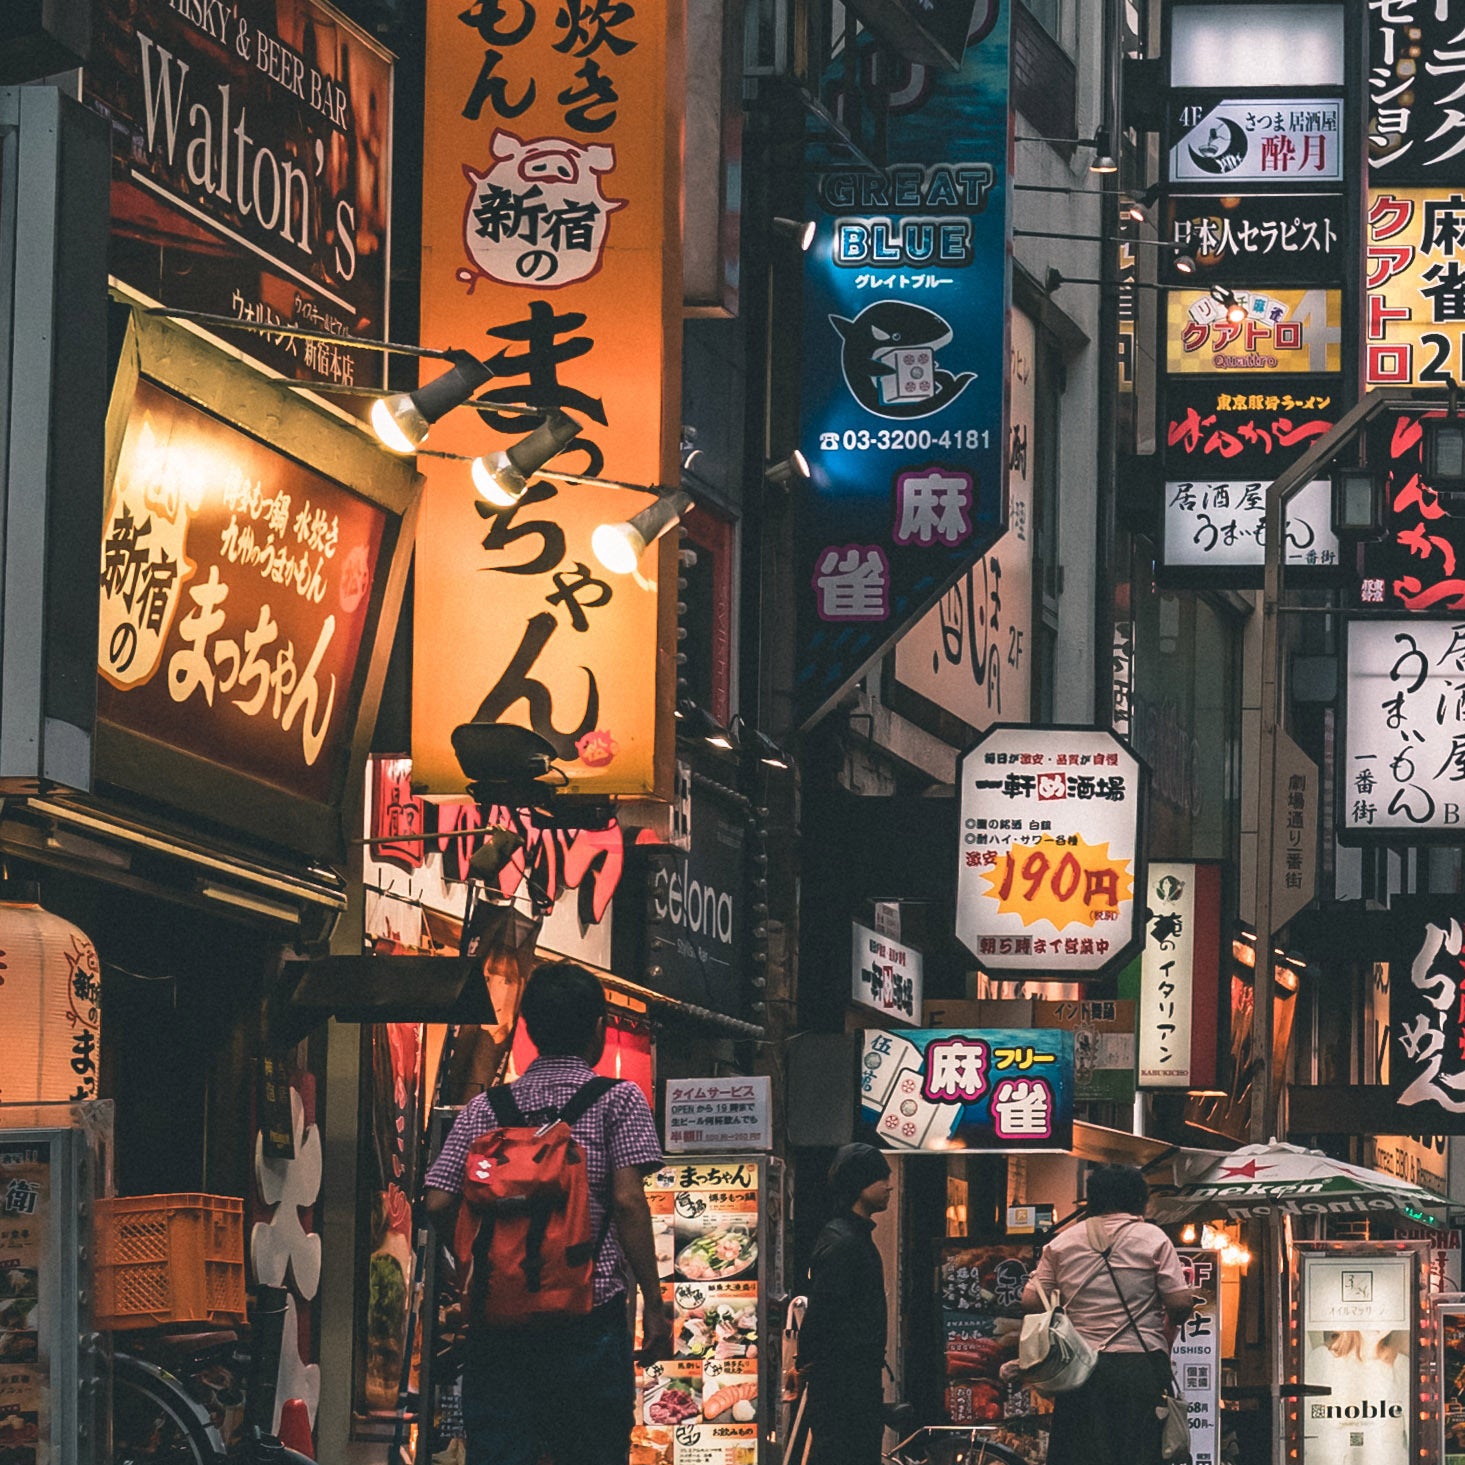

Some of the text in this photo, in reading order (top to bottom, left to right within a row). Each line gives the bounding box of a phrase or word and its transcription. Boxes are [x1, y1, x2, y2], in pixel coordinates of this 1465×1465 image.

[235, 17, 348, 130] & BEER BAR
[1179, 106, 1203, 128] 4F
[1245, 111, 1337, 132] さつま 居酒屋
[136, 30, 356, 282] Walton's
[1261, 135, 1327, 173] 酔月
[824, 169, 990, 209] GREAT
[838, 223, 969, 262] BLUE
[1173, 218, 1338, 256] 日本人セラピスト
[854, 272, 955, 291] グレイトブルー
[1367, 195, 1414, 385] クアトロ
[1181, 321, 1303, 353] クアトロ
[1213, 353, 1278, 369] Quattro
[1216, 394, 1331, 412] 東京豚骨ラーメン
[843, 430, 991, 451] 03-3200-4181
[1169, 484, 1268, 512] 居酒屋
[220, 514, 327, 603] 九州のうまかもん
[1289, 549, 1337, 565] 一番街
[1008, 625, 1024, 670] 2F
[168, 565, 336, 766] まっちゃん
[975, 772, 1126, 801] 一軒め酒場
[1353, 754, 1377, 825] 一番街
[966, 851, 997, 867] 激安
[998, 850, 1120, 907] 190円
[979, 938, 1110, 955] 朝5時まで営業中
[995, 1048, 1056, 1070] フリー
[672, 1085, 754, 1100] タイムサービス
[671, 1105, 695, 1115] OPEN
[697, 1104, 713, 1113] から
[716, 1104, 728, 1113] 19
[671, 1115, 758, 1127] 生ビール何杯飲んでも
[670, 1130, 703, 1144] 半額!!
[680, 1165, 750, 1188] まっちゃん
[1186, 1366, 1209, 1377] 個室
[1186, 1377, 1209, 1388] 完備
[1325, 1400, 1403, 1419] noble
